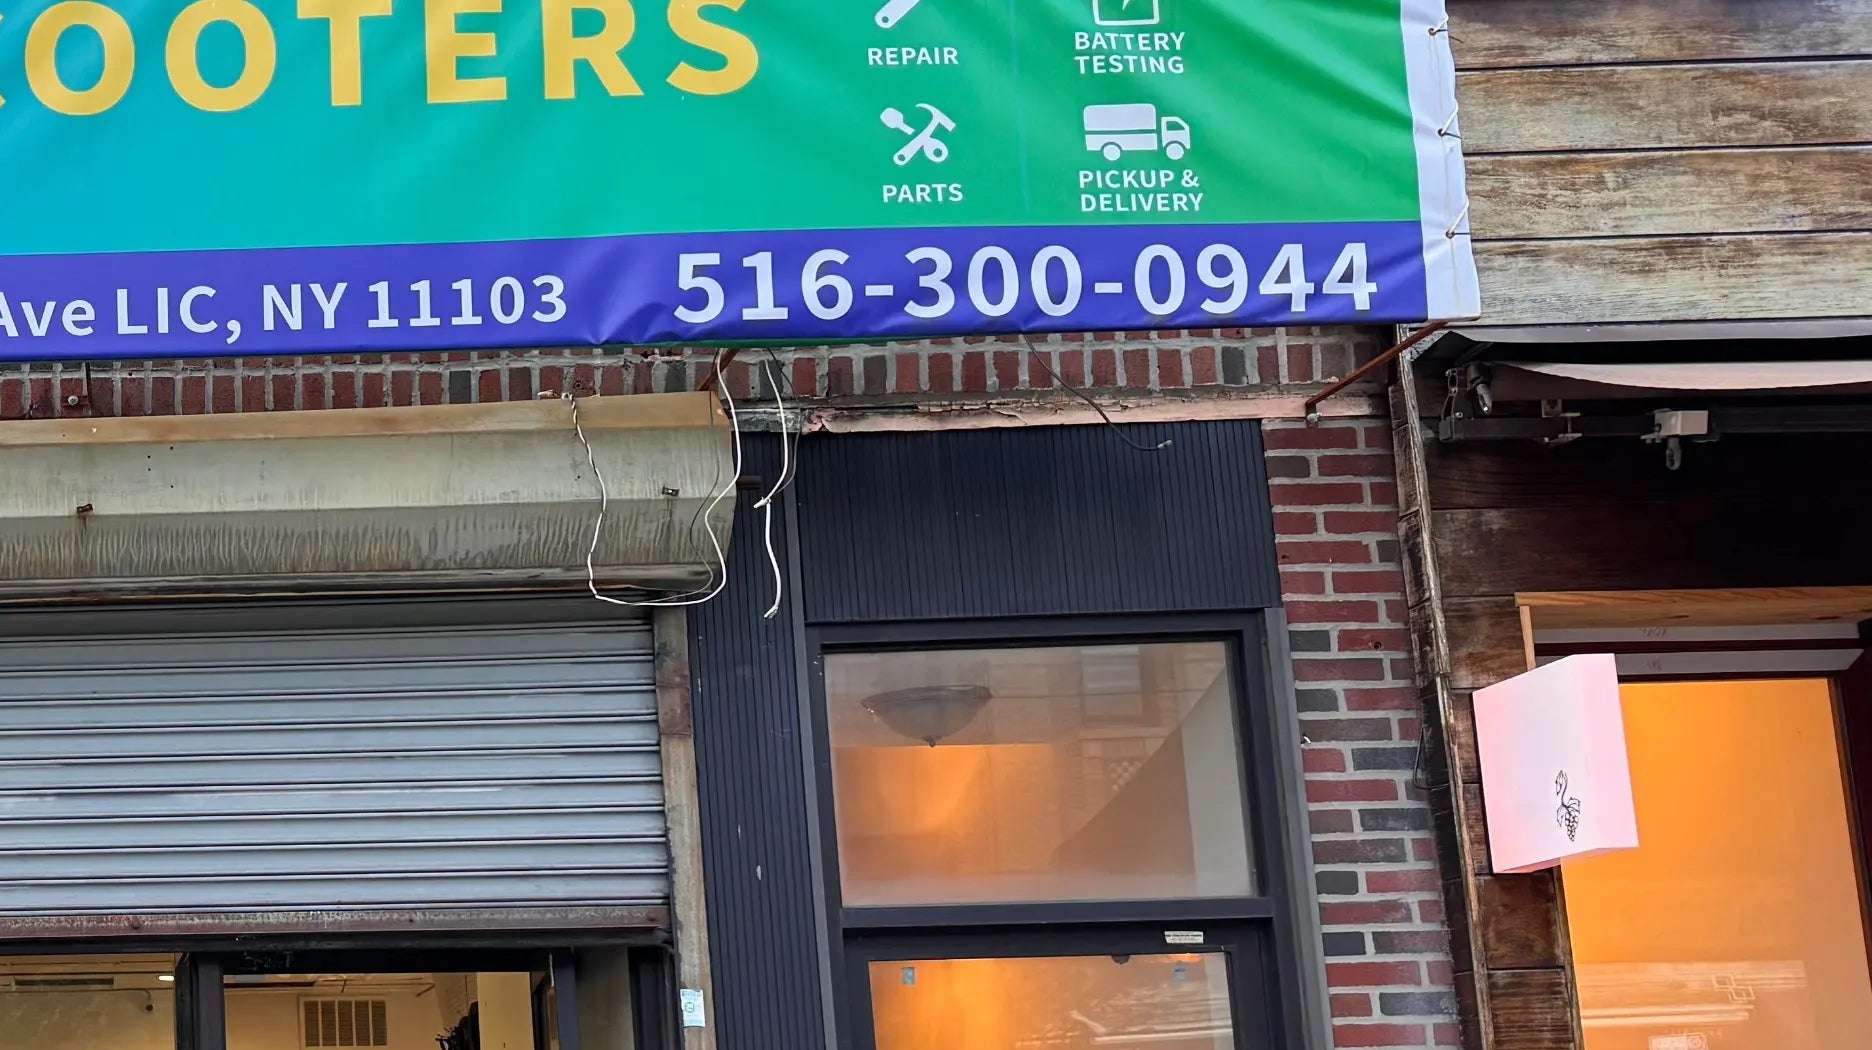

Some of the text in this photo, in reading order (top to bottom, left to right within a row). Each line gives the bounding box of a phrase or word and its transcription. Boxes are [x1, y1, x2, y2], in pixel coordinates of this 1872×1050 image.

[1075, 32, 1185, 51] BATTERY
[868, 47, 959, 65] REPAIR
[1076, 55, 1185, 74] TESTING
[1078, 169, 1199, 189] PICKUP &
[883, 183, 964, 203] PARTS
[1080, 193, 1204, 211] DELIVERY
[673, 242, 1379, 325] 516-300-0944
[116, 285, 242, 345] LIC,
[263, 282, 349, 332] NY
[366, 275, 568, 328] 11103
